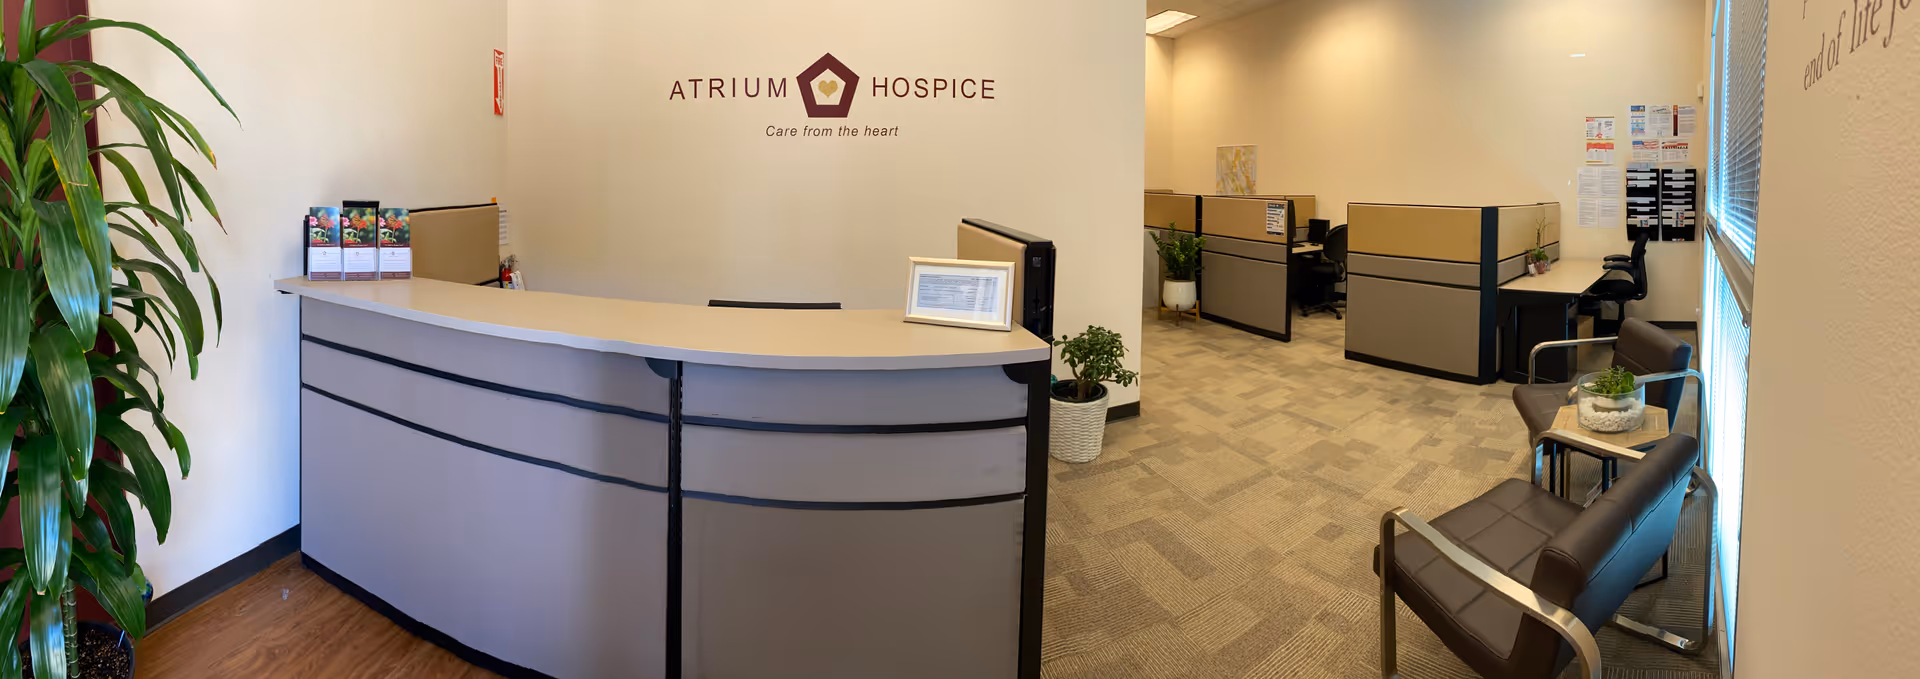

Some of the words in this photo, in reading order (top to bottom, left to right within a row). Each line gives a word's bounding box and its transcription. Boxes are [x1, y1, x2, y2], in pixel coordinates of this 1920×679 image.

[1803, 32, 1825, 91] end
[1826, 9, 1847, 72] of
[1849, 0, 1883, 54] life
[669, 77, 787, 101] ATRIUM
[872, 76, 995, 100] HOSPICE
[765, 125, 798, 137] Care
[803, 125, 833, 137] from
[838, 125, 859, 137] the
[864, 125, 899, 137] heart
